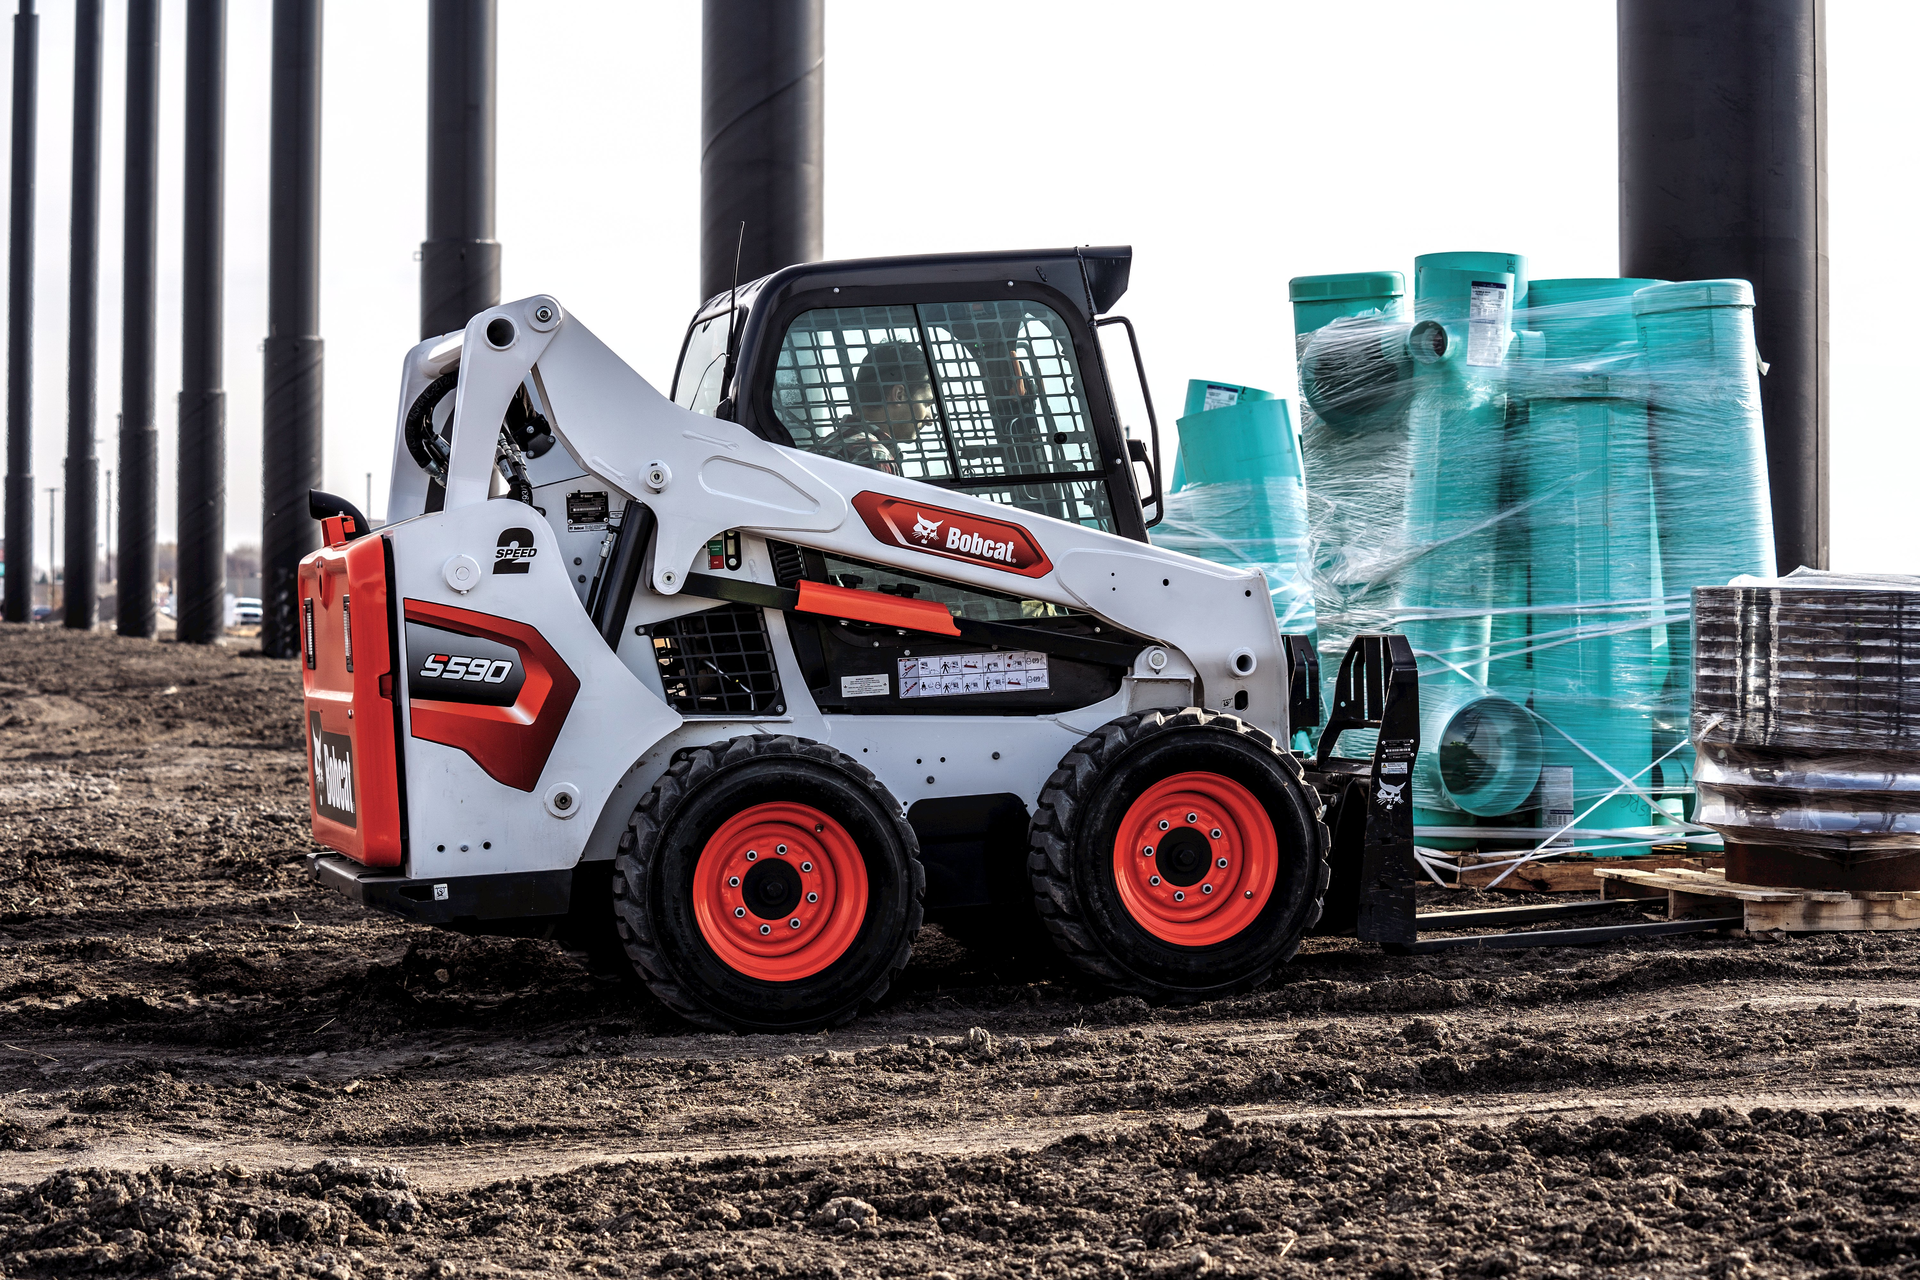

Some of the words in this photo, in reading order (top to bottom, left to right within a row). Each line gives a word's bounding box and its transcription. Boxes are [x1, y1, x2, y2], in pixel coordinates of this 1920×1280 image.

[492, 527, 535, 574] 2
[495, 548, 538, 558] SPEED
[946, 527, 1014, 562] Bobcat
[420, 654, 513, 684] S590
[324, 744, 354, 814] Bobcat
